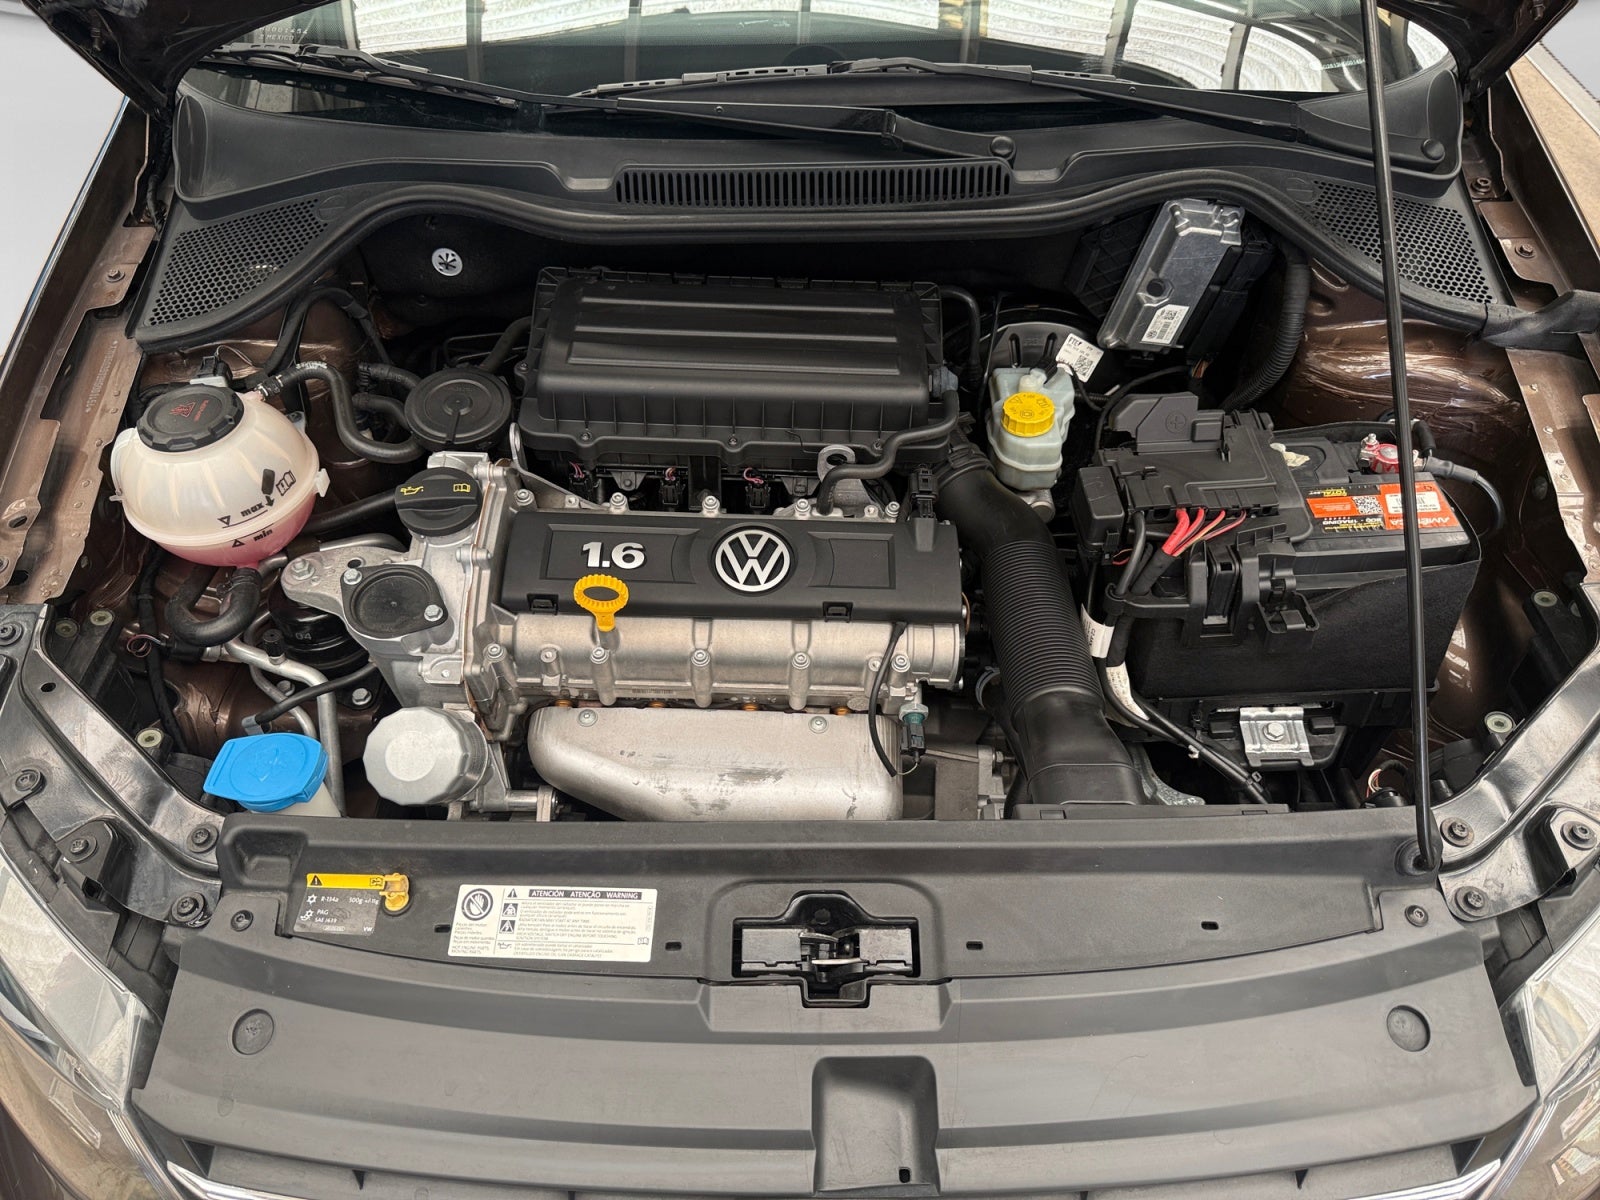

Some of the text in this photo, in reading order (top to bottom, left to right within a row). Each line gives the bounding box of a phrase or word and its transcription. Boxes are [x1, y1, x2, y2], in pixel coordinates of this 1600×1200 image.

[240, 502, 265, 517] max
[253, 529, 273, 541] min
[582, 541, 645, 569] 1.6
[531, 889, 639, 899] ATENCIÓN ATENÇÃO WARNING
